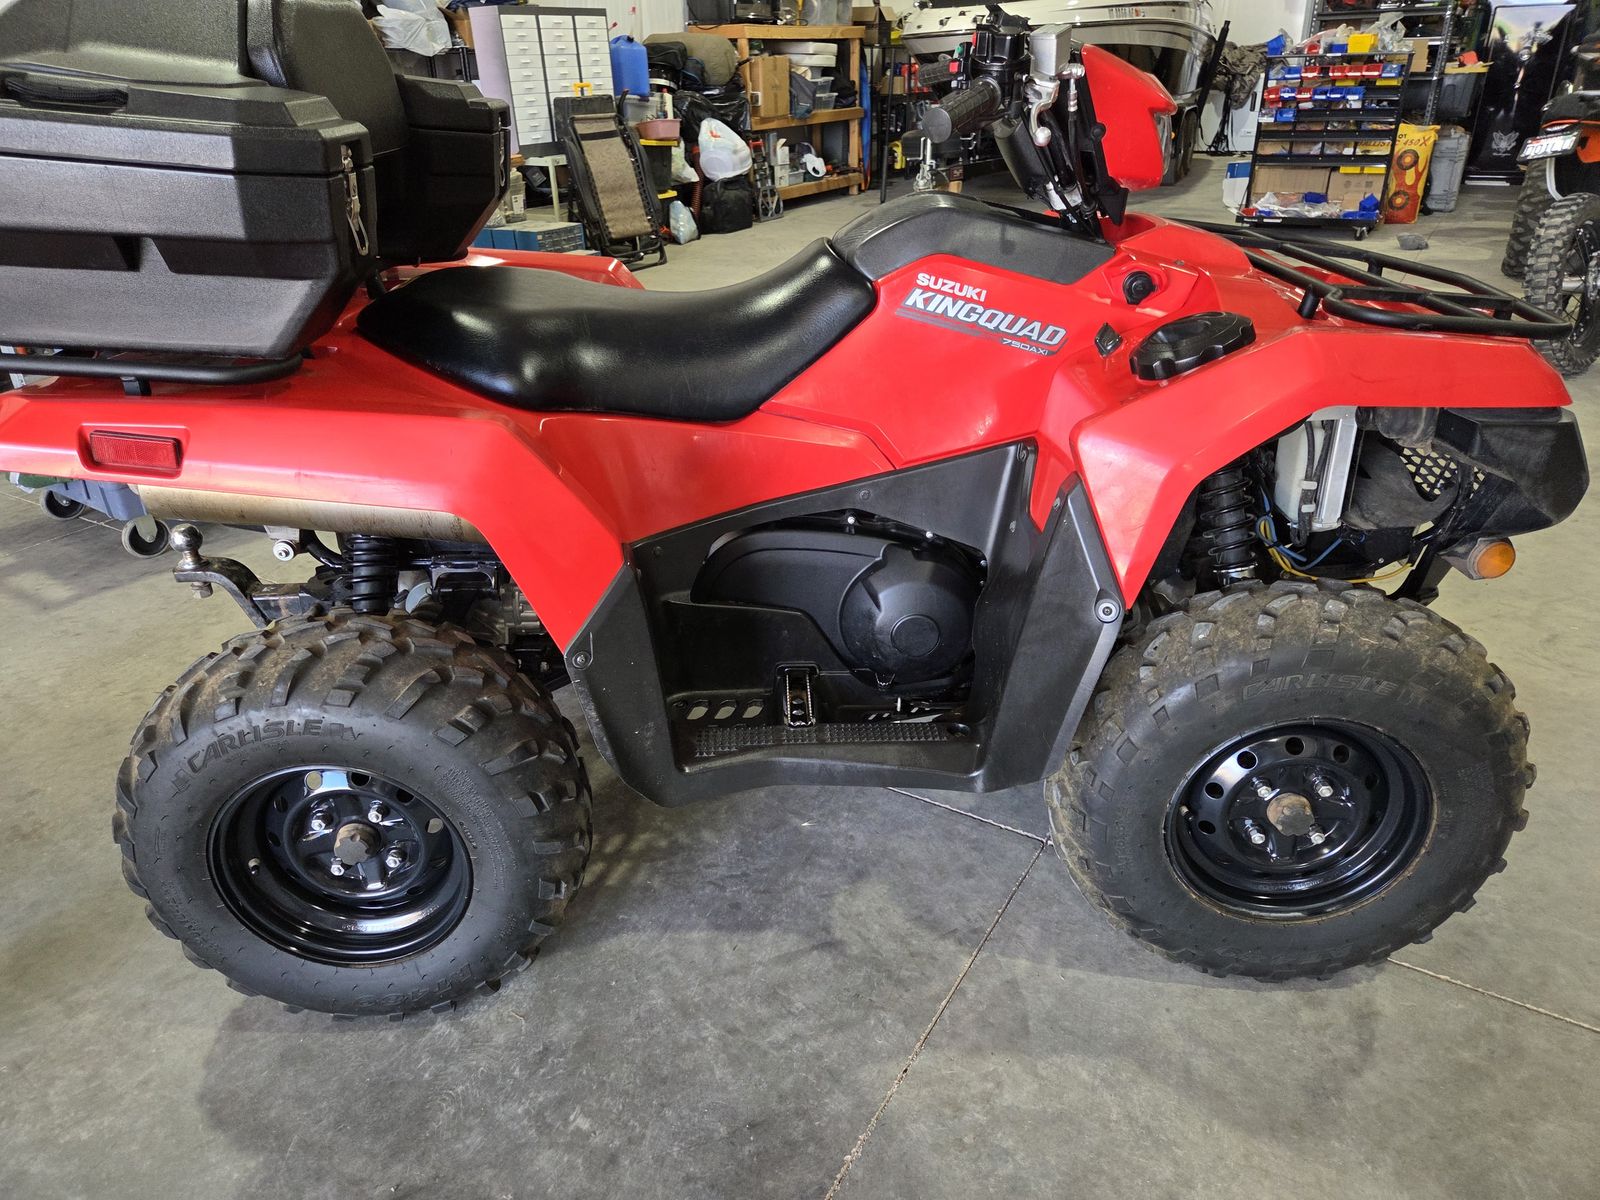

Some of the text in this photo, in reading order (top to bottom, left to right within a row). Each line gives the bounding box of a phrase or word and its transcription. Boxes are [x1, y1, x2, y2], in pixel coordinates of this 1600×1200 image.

[916, 272, 987, 302] SUZUKI
[904, 287, 1067, 346] KINGQUAD
[1242, 672, 1399, 701] CARLISLE
[187, 718, 324, 775] CARLISLE
